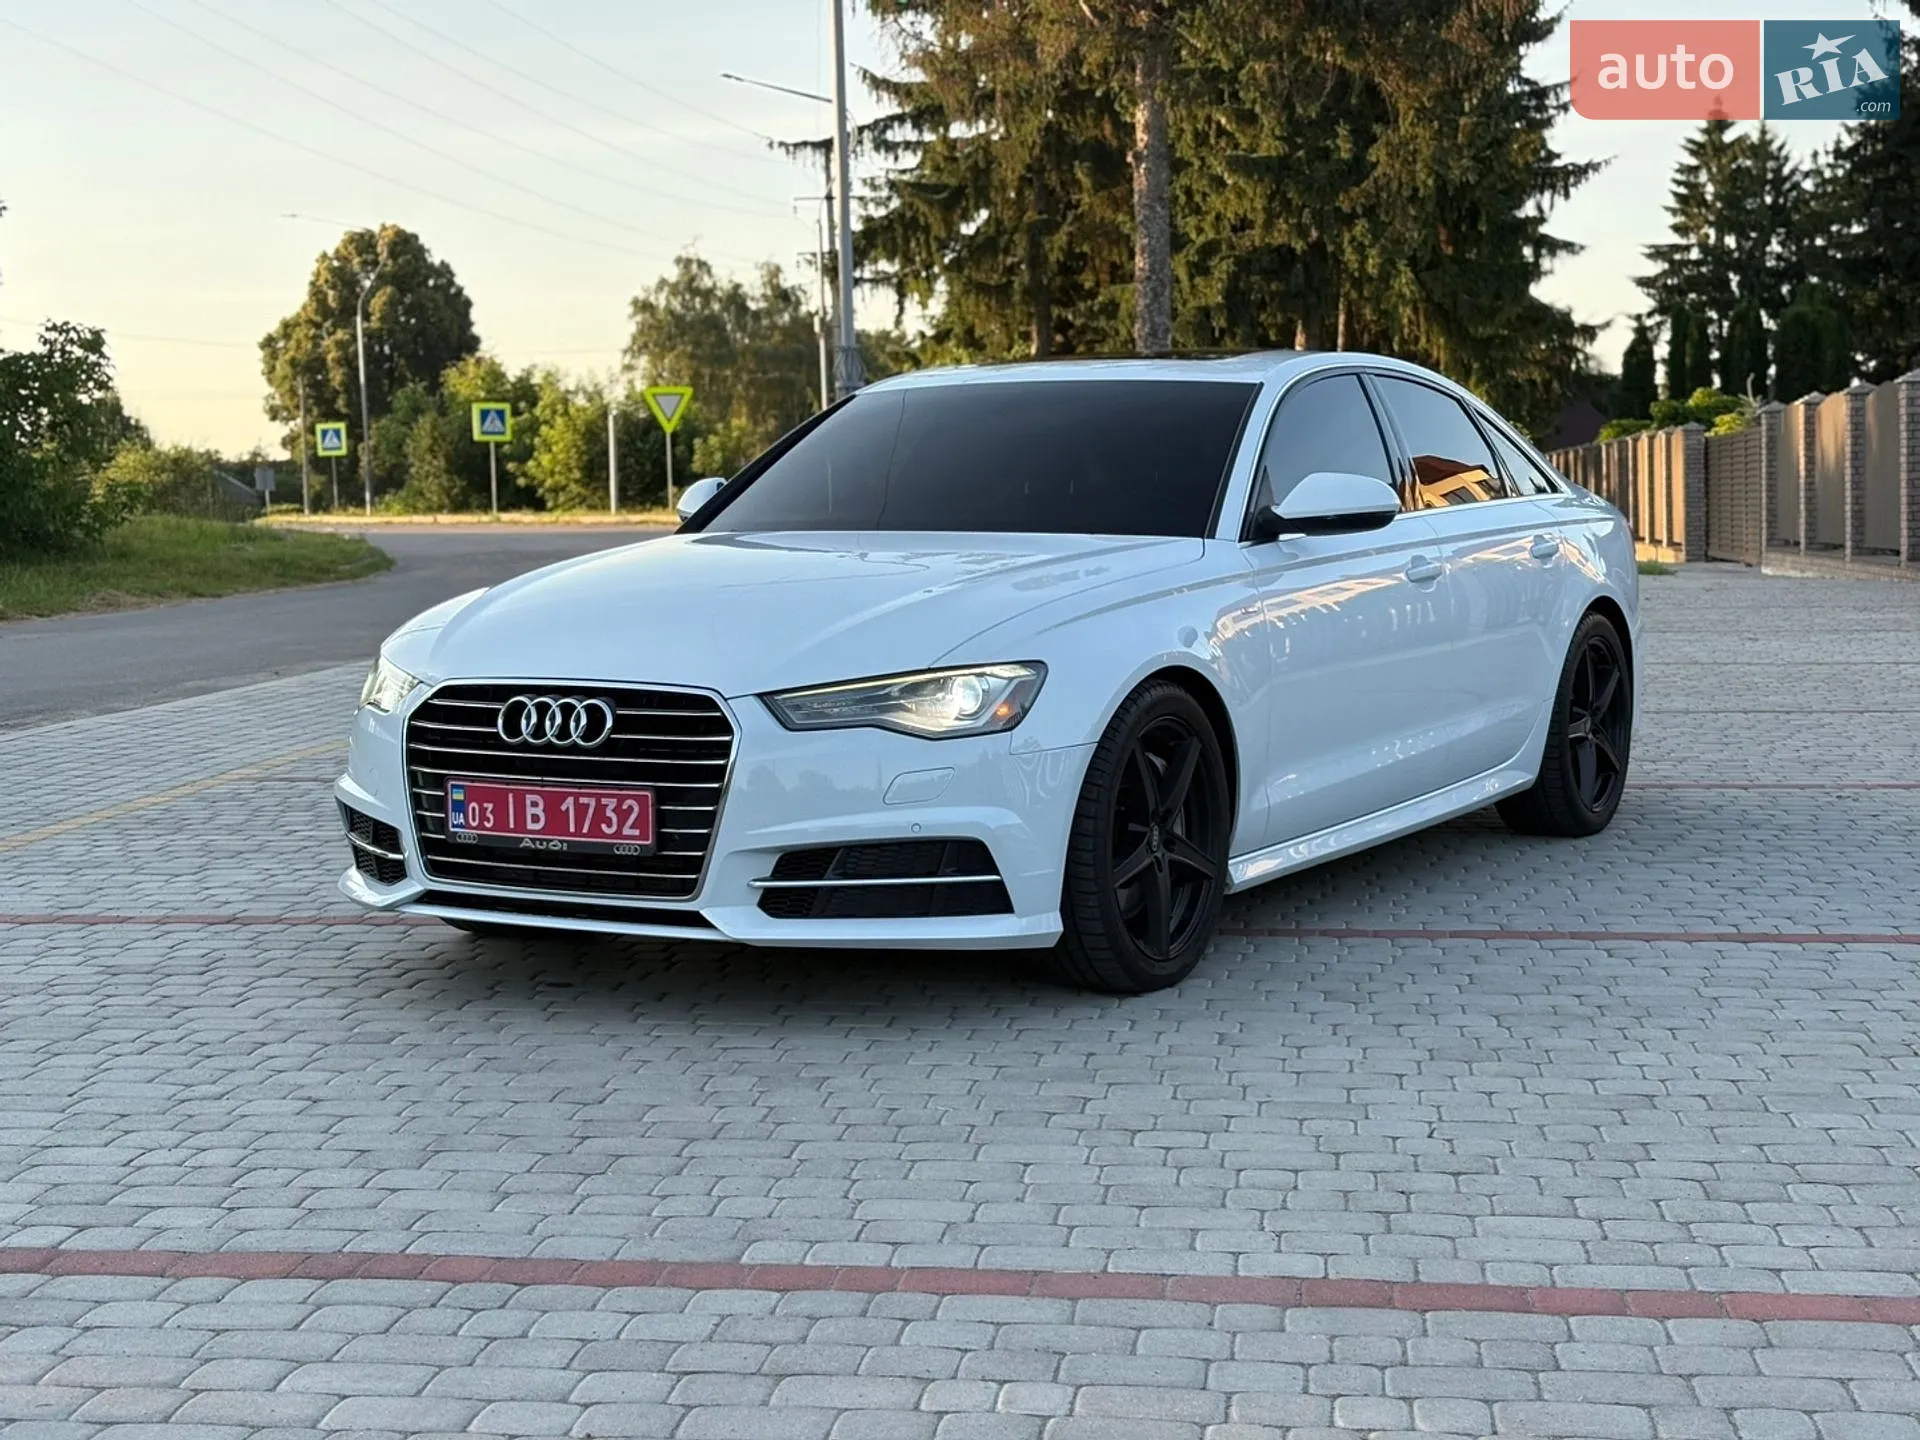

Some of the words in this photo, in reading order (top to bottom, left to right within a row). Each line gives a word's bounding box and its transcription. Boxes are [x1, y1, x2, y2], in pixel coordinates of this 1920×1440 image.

[452, 811, 465, 826] UA
[468, 802, 494, 828] 03
[560, 796, 640, 836] 1732
